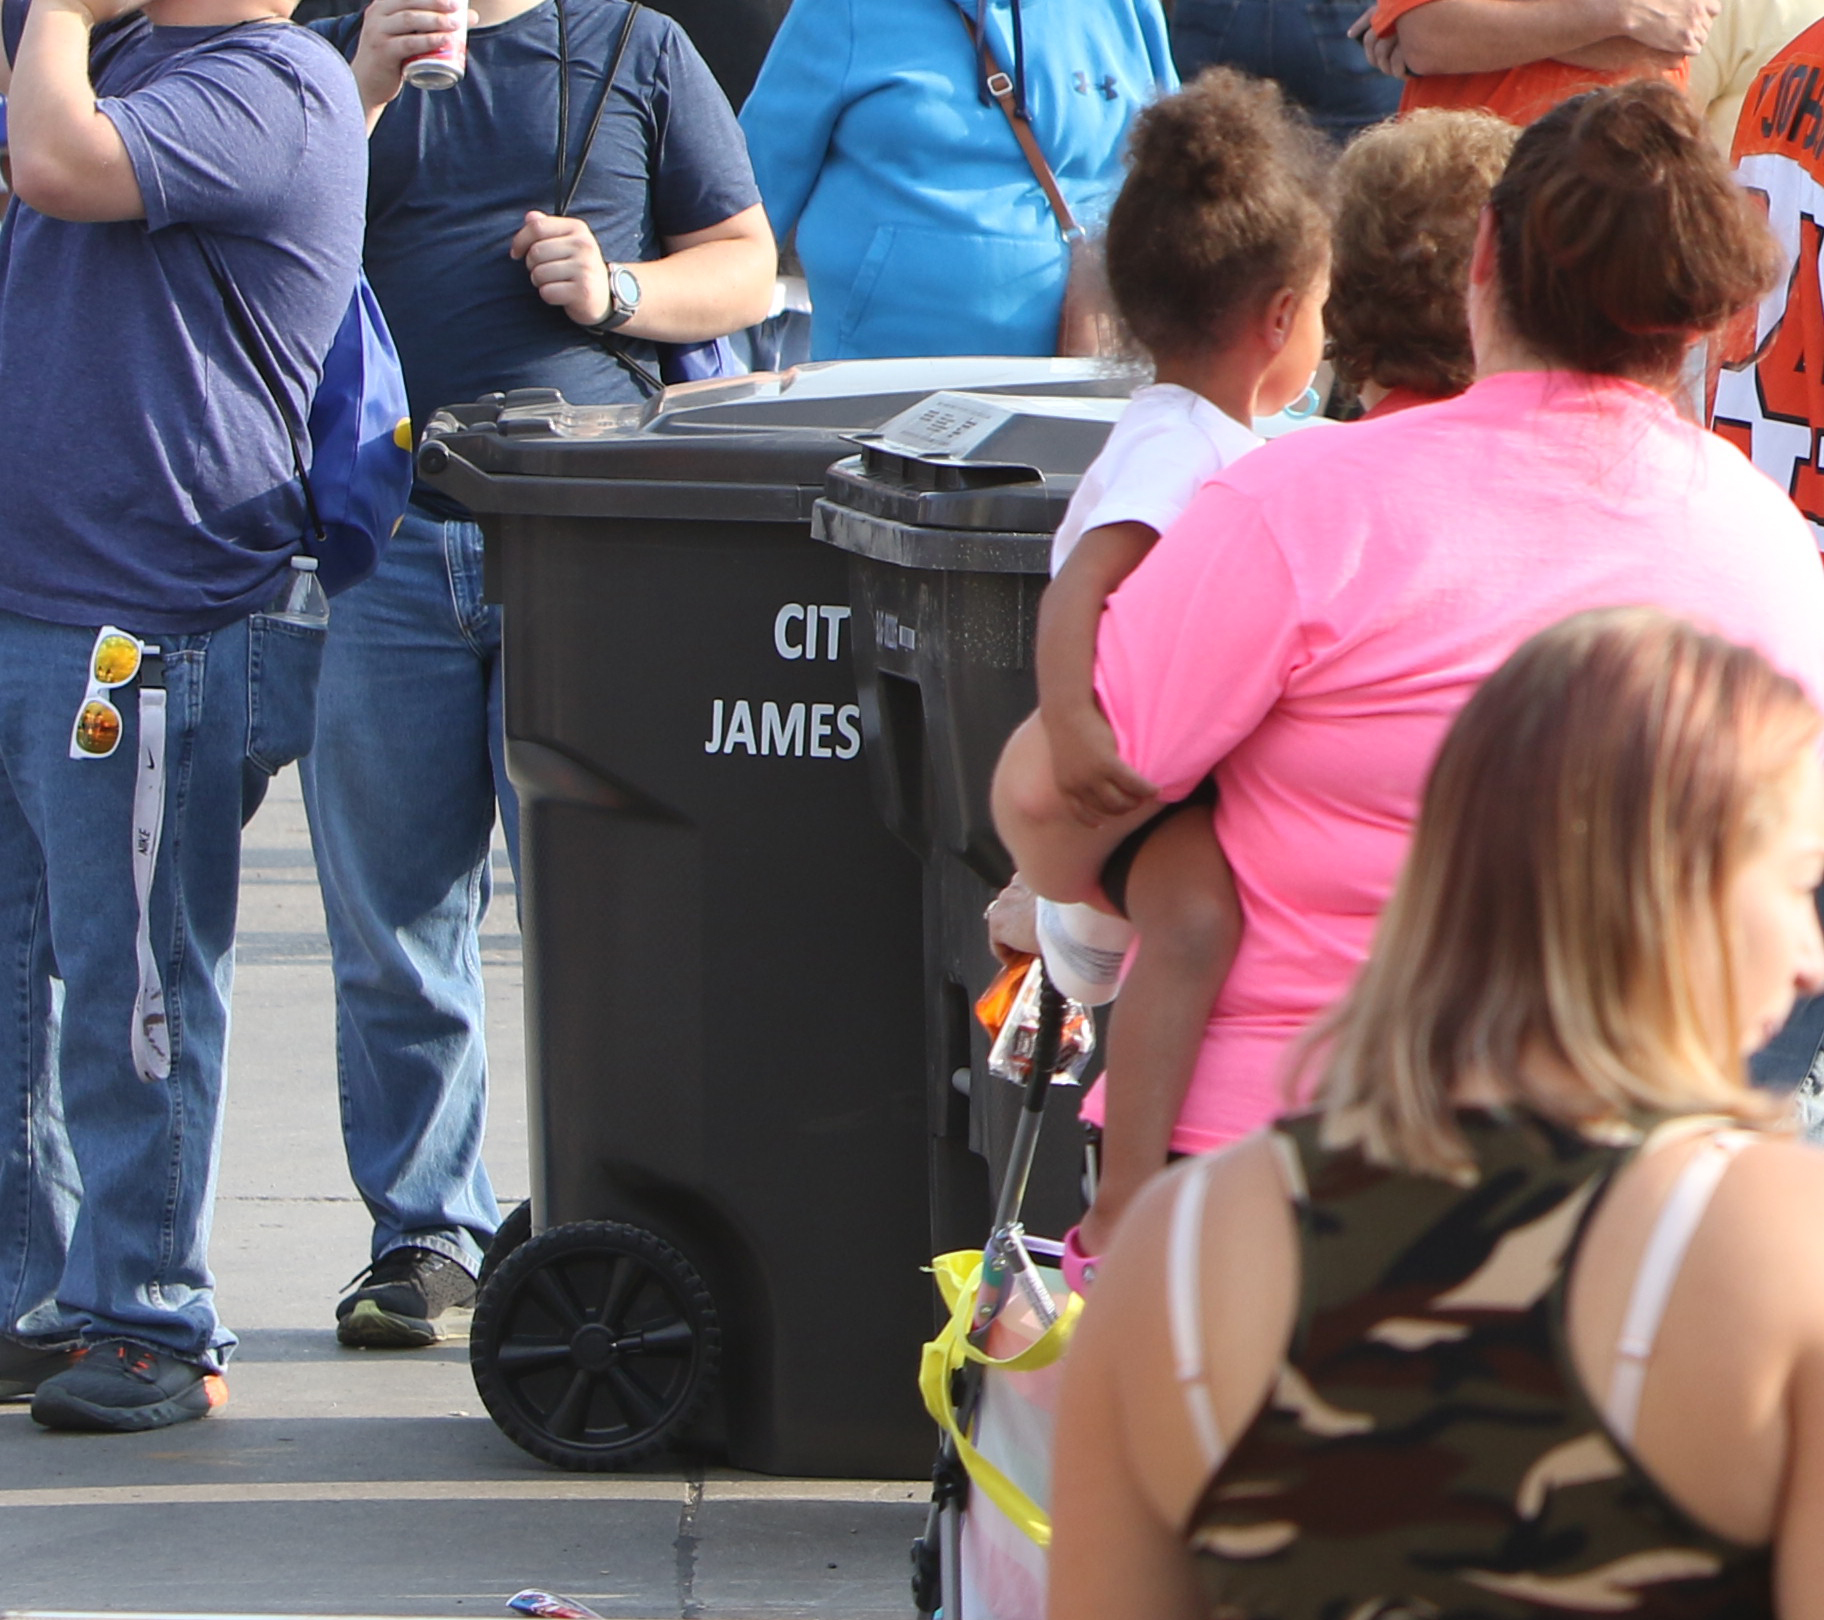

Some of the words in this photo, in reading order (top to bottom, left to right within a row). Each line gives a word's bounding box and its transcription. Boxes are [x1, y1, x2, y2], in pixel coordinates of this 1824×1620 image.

[774, 602, 852, 661] CIT
[704, 698, 862, 760] JAMES
[138, 827, 151, 857] NIKE
